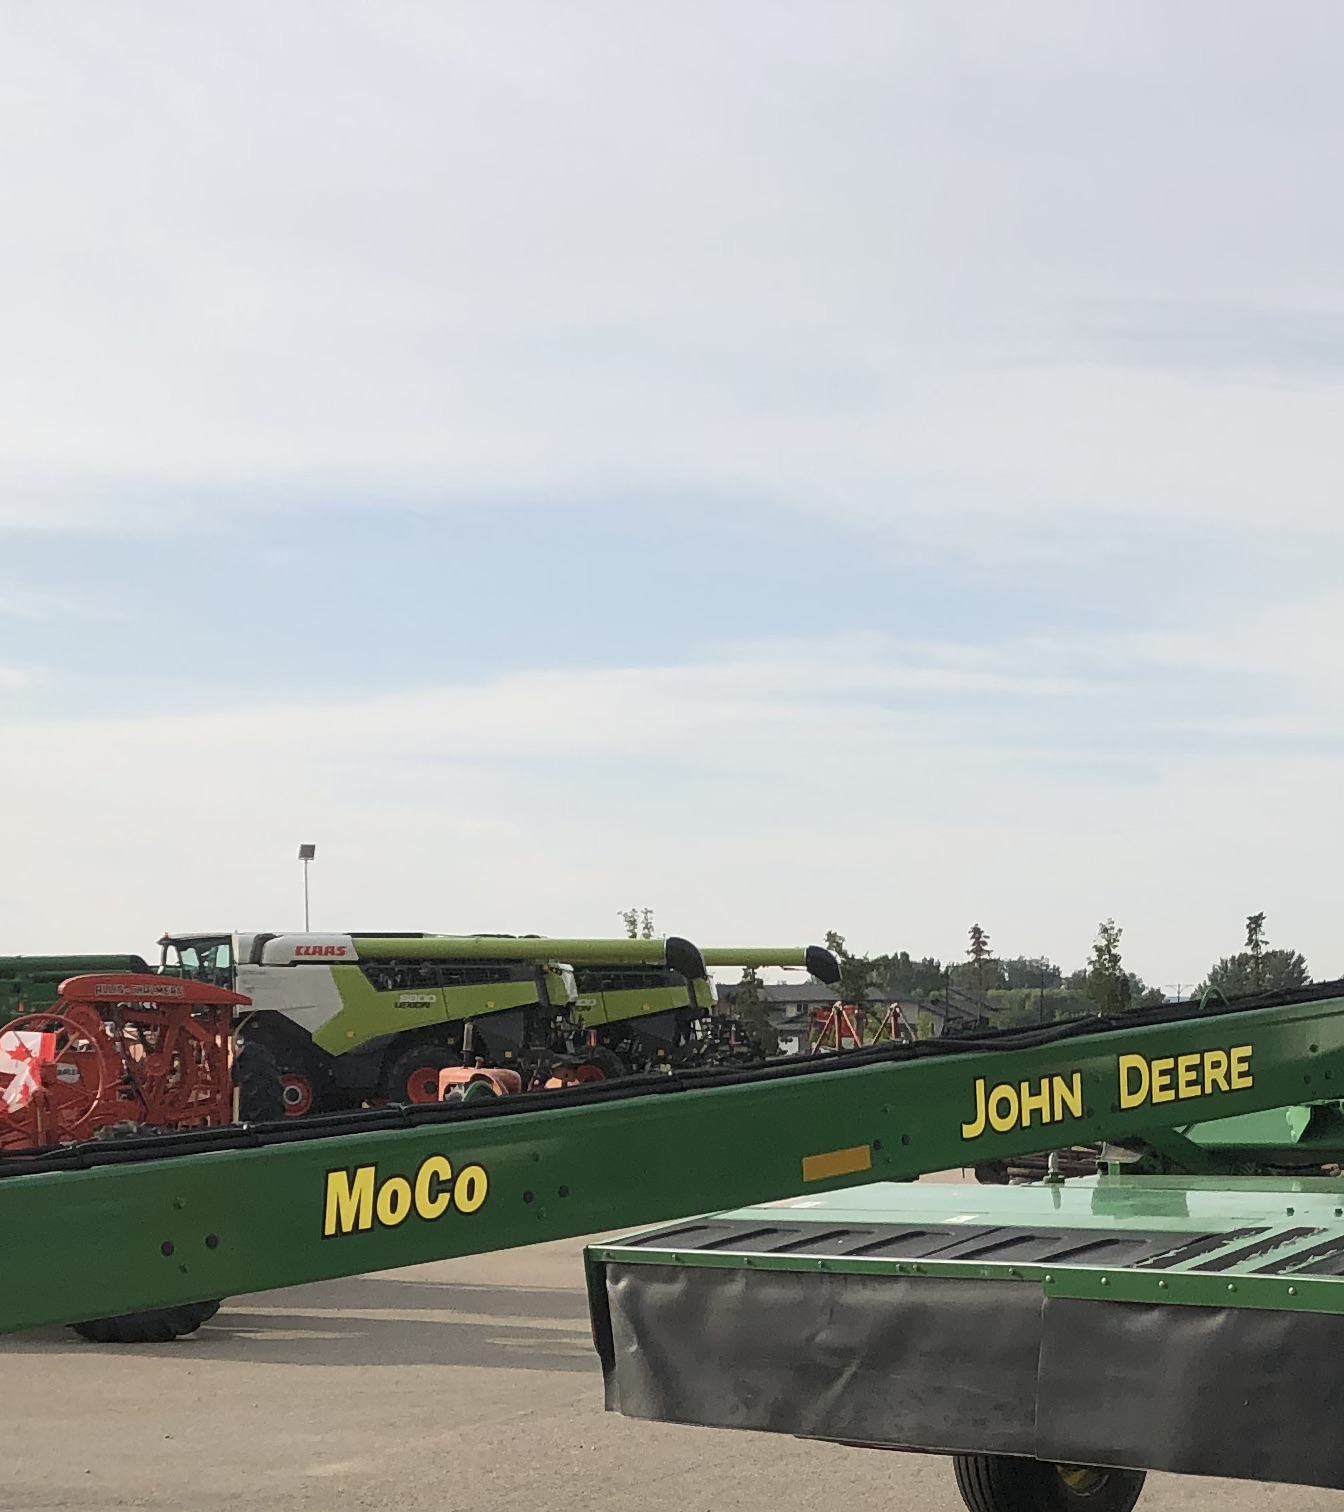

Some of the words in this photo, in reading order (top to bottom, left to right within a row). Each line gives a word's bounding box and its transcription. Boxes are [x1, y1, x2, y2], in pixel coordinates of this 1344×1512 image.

[294, 945, 347, 957] CLAAS
[960, 1070, 1084, 1140] JOHN
[1117, 1044, 1254, 1111] DEERE
[322, 1153, 489, 1238] MoCo
